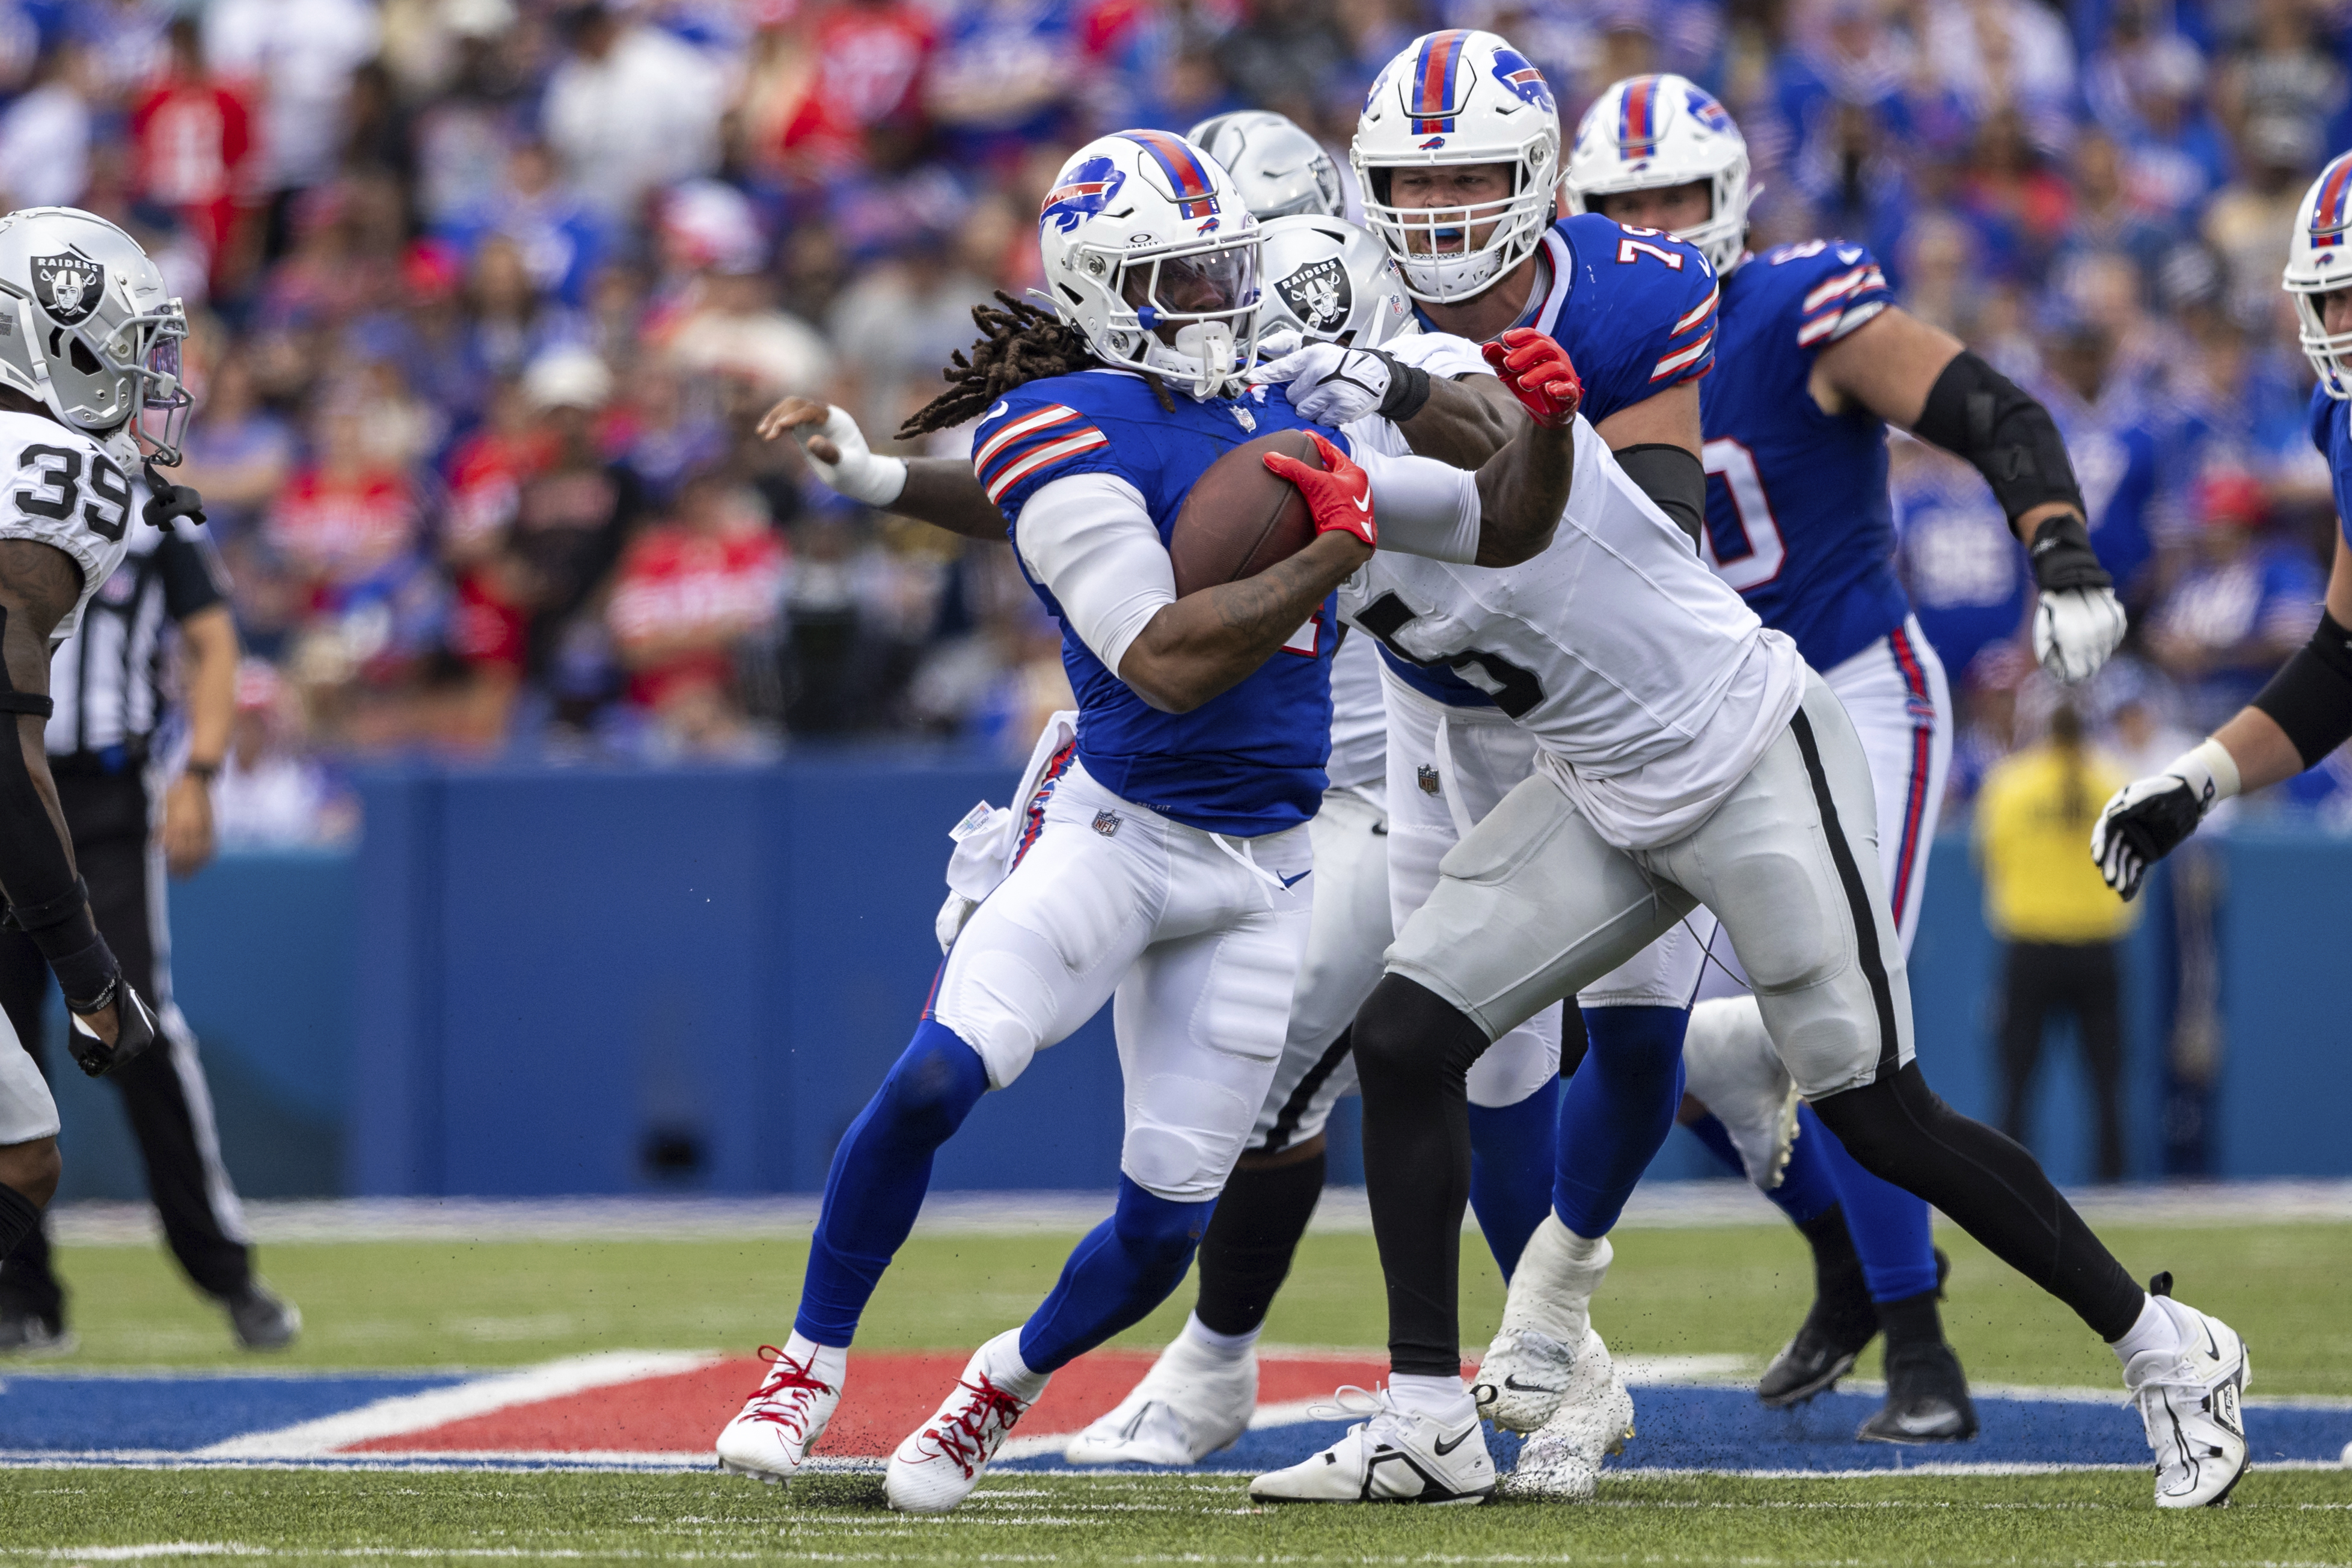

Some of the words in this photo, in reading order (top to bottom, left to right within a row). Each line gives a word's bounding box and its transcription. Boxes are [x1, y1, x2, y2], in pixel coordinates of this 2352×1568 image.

[38, 258, 98, 272] RAIDERS
[1281, 260, 1337, 290] RAIDERS
[13, 443, 132, 545] 39
[1421, 777, 1436, 790] NFL
[1095, 819, 1112, 833] NFL
